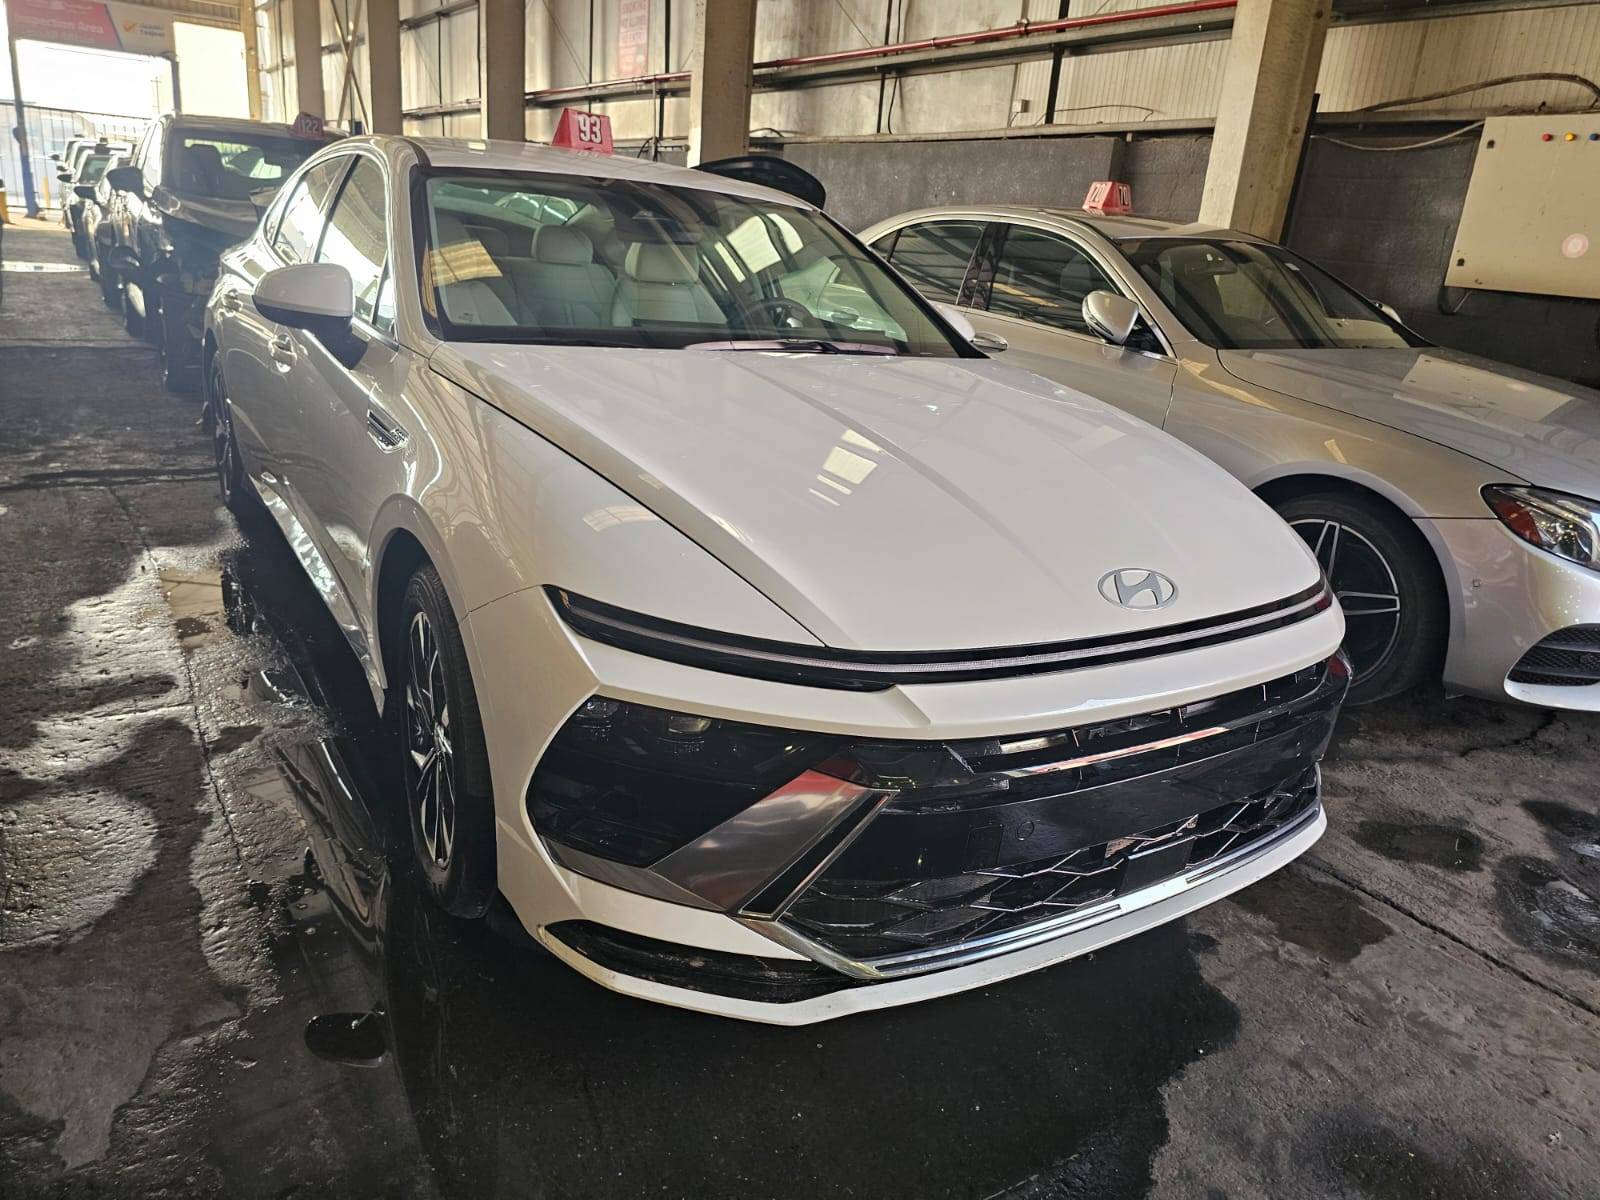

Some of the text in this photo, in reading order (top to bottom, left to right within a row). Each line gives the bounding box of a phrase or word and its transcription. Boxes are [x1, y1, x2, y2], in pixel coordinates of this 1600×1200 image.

[15, 15, 105, 35] ection Area
[301, 119, 319, 133] 122
[577, 113, 602, 144] 93
[1089, 183, 1107, 203] 70
